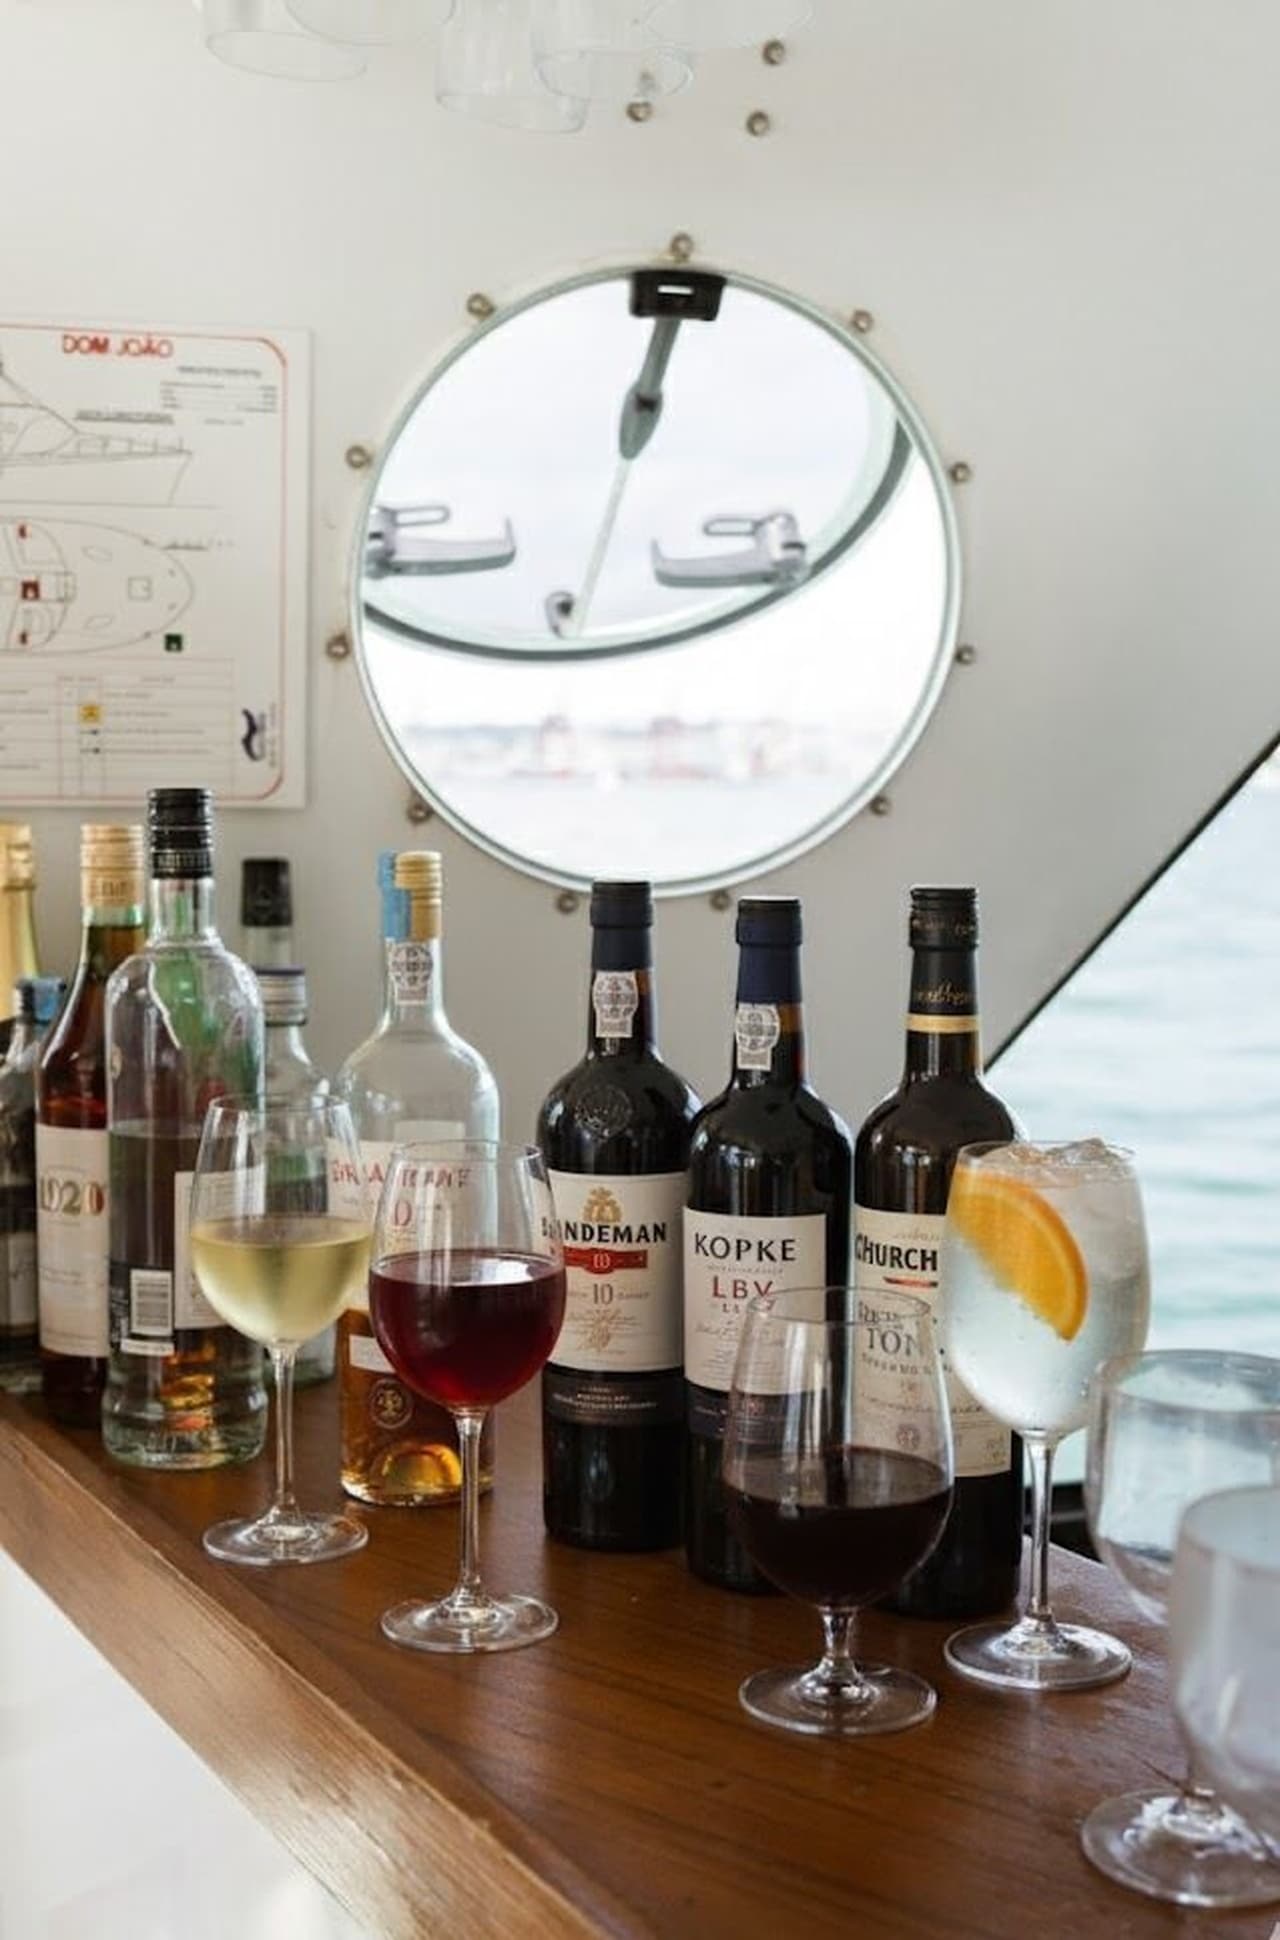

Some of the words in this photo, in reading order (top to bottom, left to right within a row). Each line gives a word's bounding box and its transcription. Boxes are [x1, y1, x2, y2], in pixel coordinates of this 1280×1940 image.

[62, 334, 109, 354] DOM
[117, 332, 174, 358] JOÃO
[695, 1233, 797, 1262] KOPKE
[593, 1283, 613, 1305] 10
[713, 1275, 773, 1299] LBV
